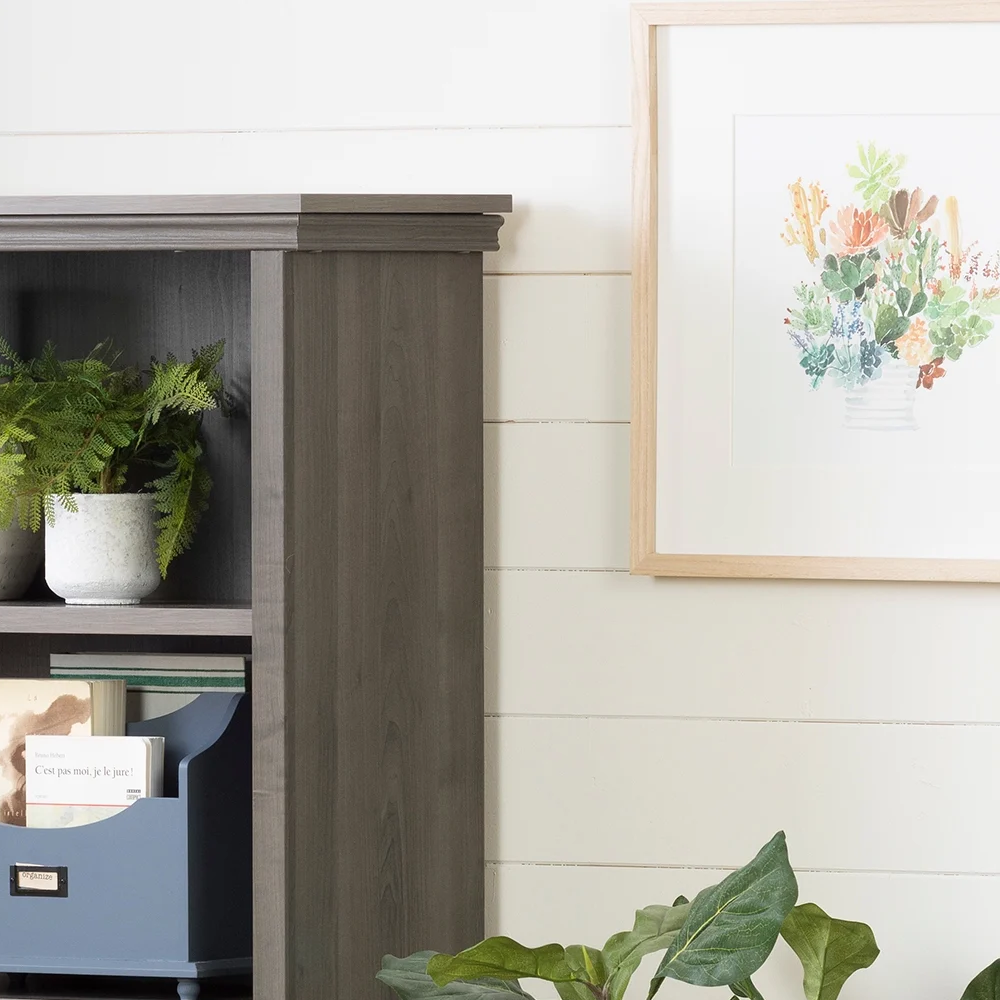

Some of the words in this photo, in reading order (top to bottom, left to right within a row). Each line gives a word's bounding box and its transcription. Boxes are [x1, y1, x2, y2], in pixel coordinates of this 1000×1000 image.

[34, 764, 55, 776] C'est
[57, 768, 71, 778] pas
[73, 767, 91, 777] moi,
[92, 767, 102, 779] je
[103, 766, 111, 777] le
[22, 871, 53, 881] organize
